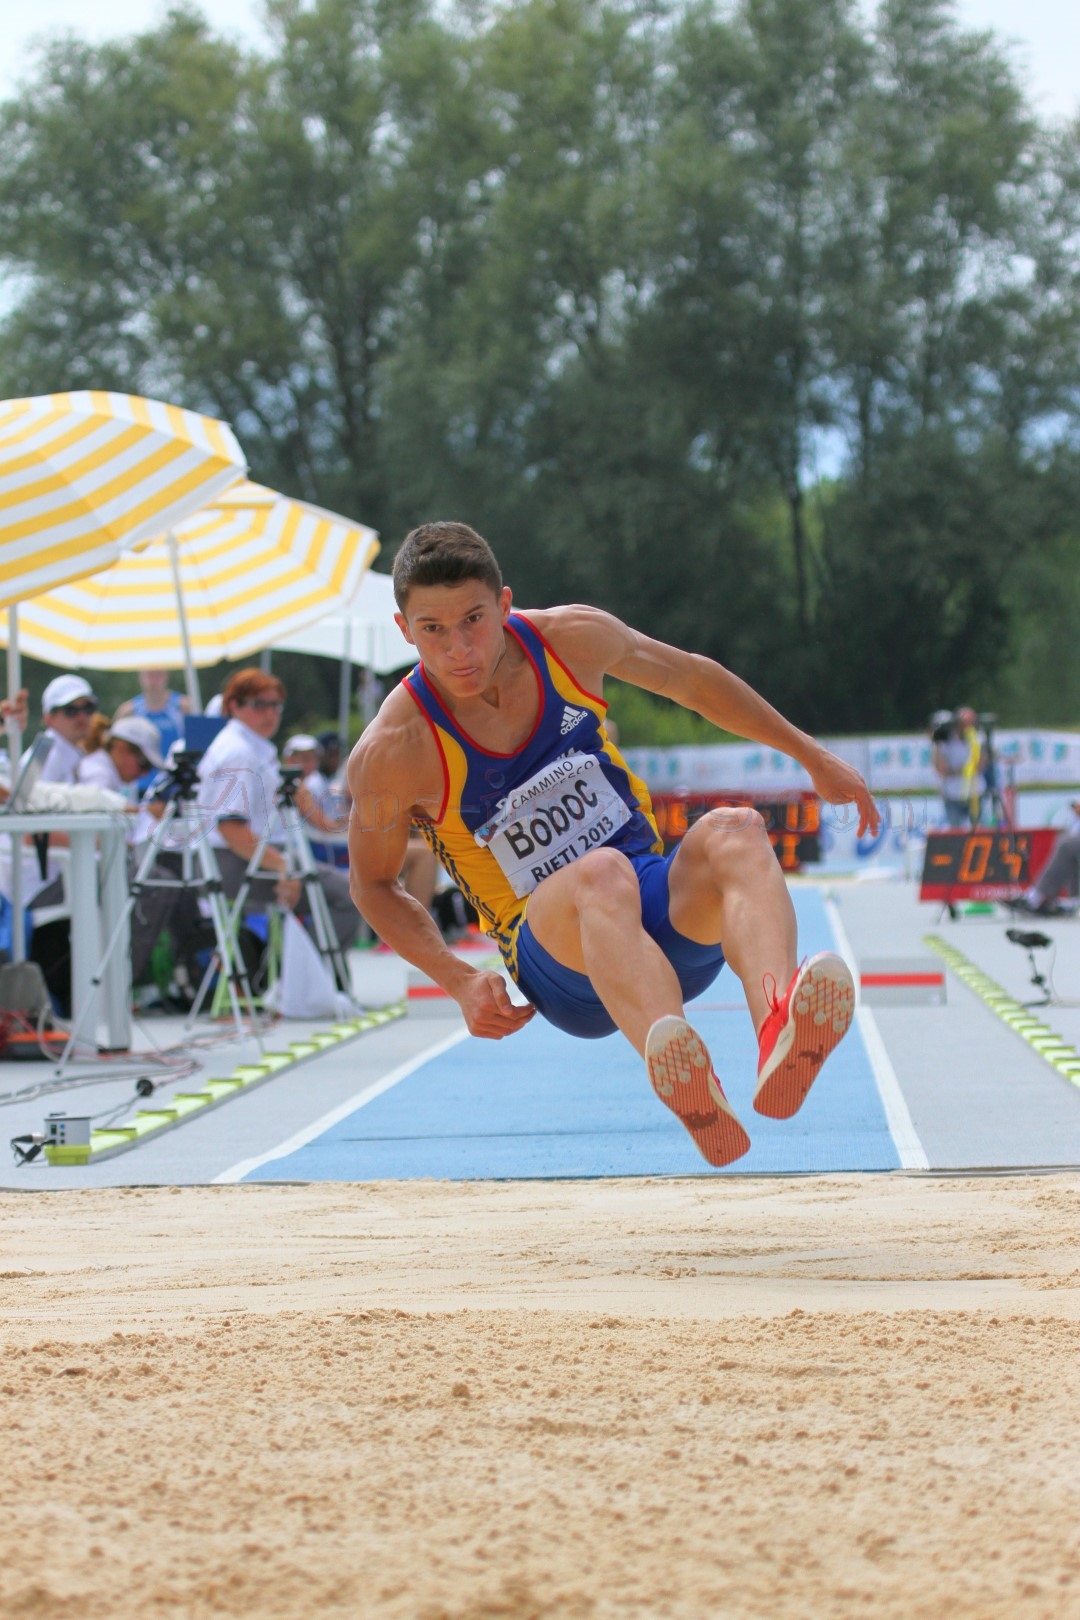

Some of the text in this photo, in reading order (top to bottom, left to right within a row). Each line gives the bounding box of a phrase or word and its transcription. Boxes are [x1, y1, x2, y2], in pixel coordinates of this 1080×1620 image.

[560, 710, 588, 735] adidas
[511, 761, 573, 809] CAMMINO
[531, 844, 579, 883] RIETI
[577, 816, 614, 850] 2013
